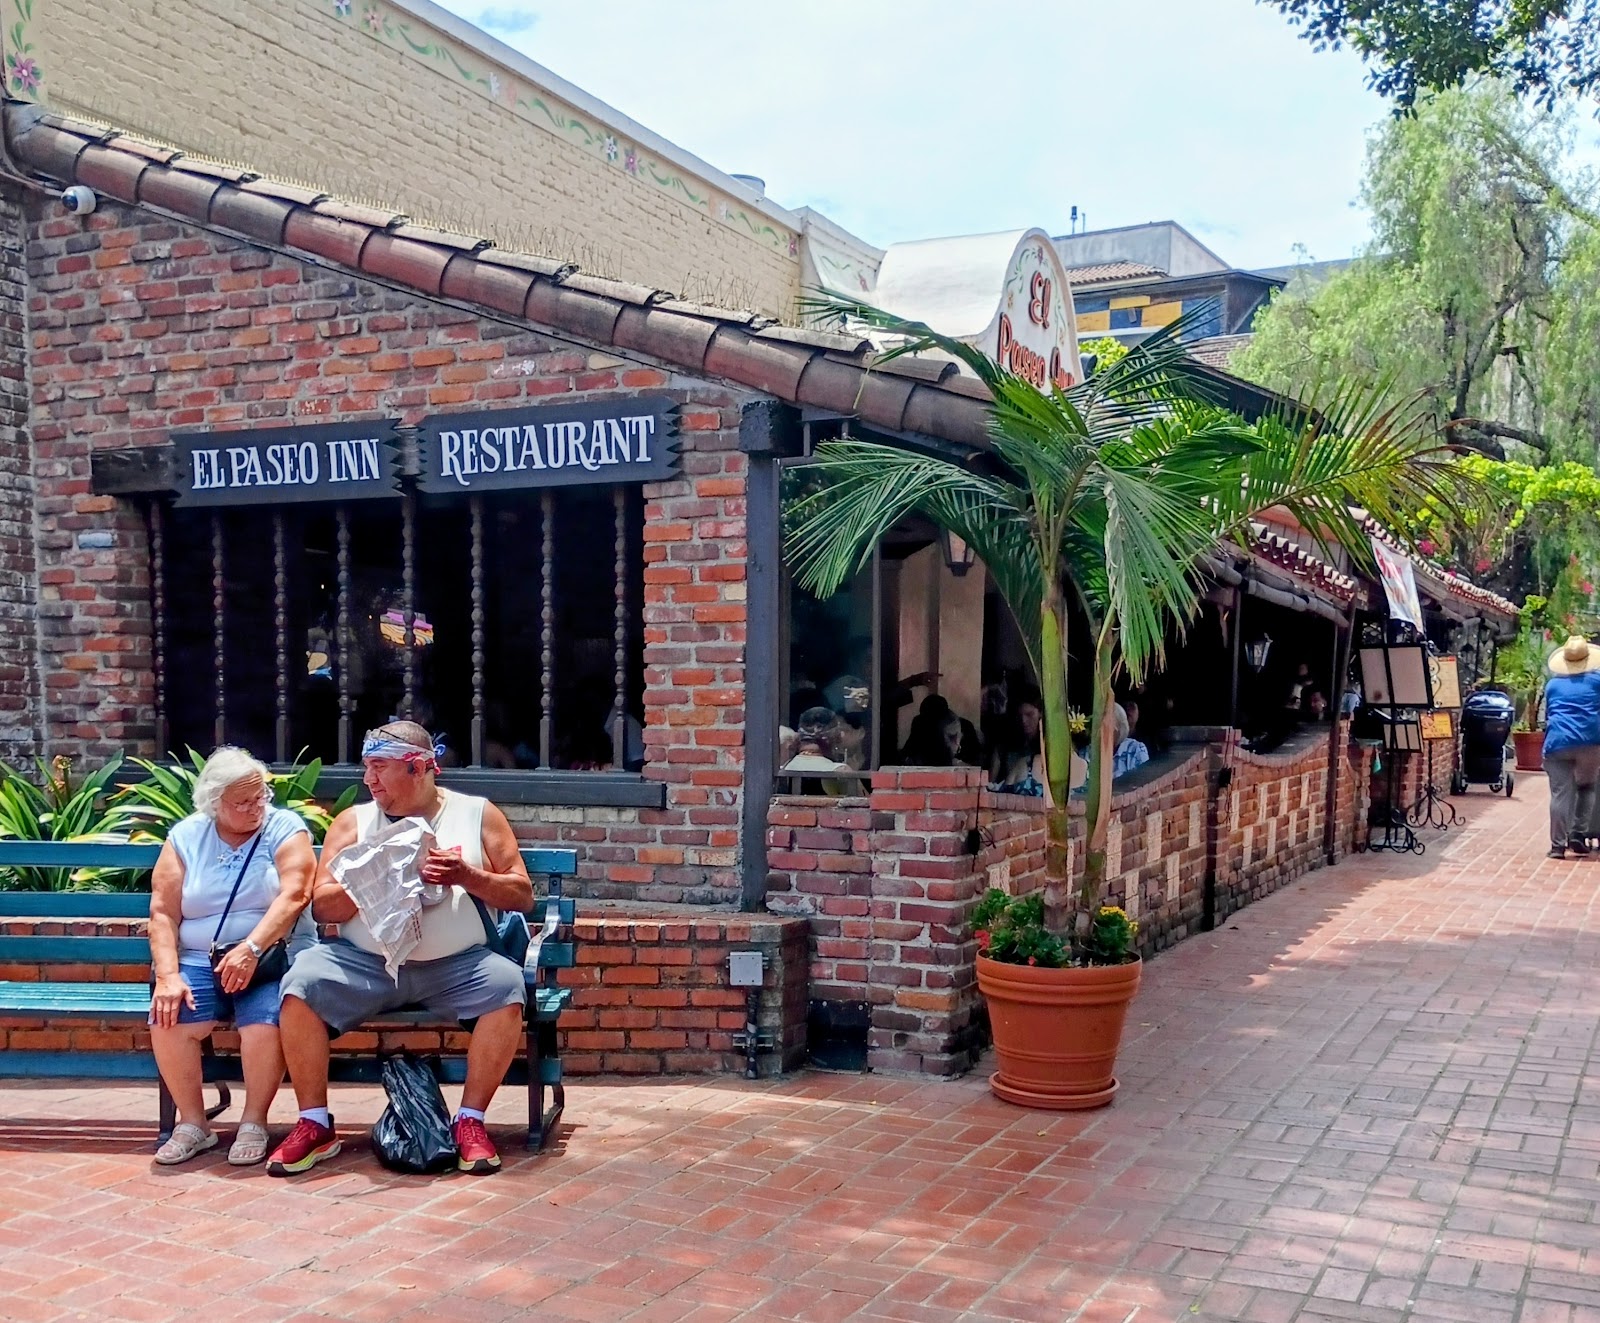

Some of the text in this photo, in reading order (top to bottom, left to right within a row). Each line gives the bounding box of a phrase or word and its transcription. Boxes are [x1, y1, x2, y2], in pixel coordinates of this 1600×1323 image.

[1029, 271, 1051, 329] El
[998, 312, 1046, 388] Paseo
[191, 438, 380, 490] EL PASEO INN
[439, 414, 655, 486] RESTAURANT
